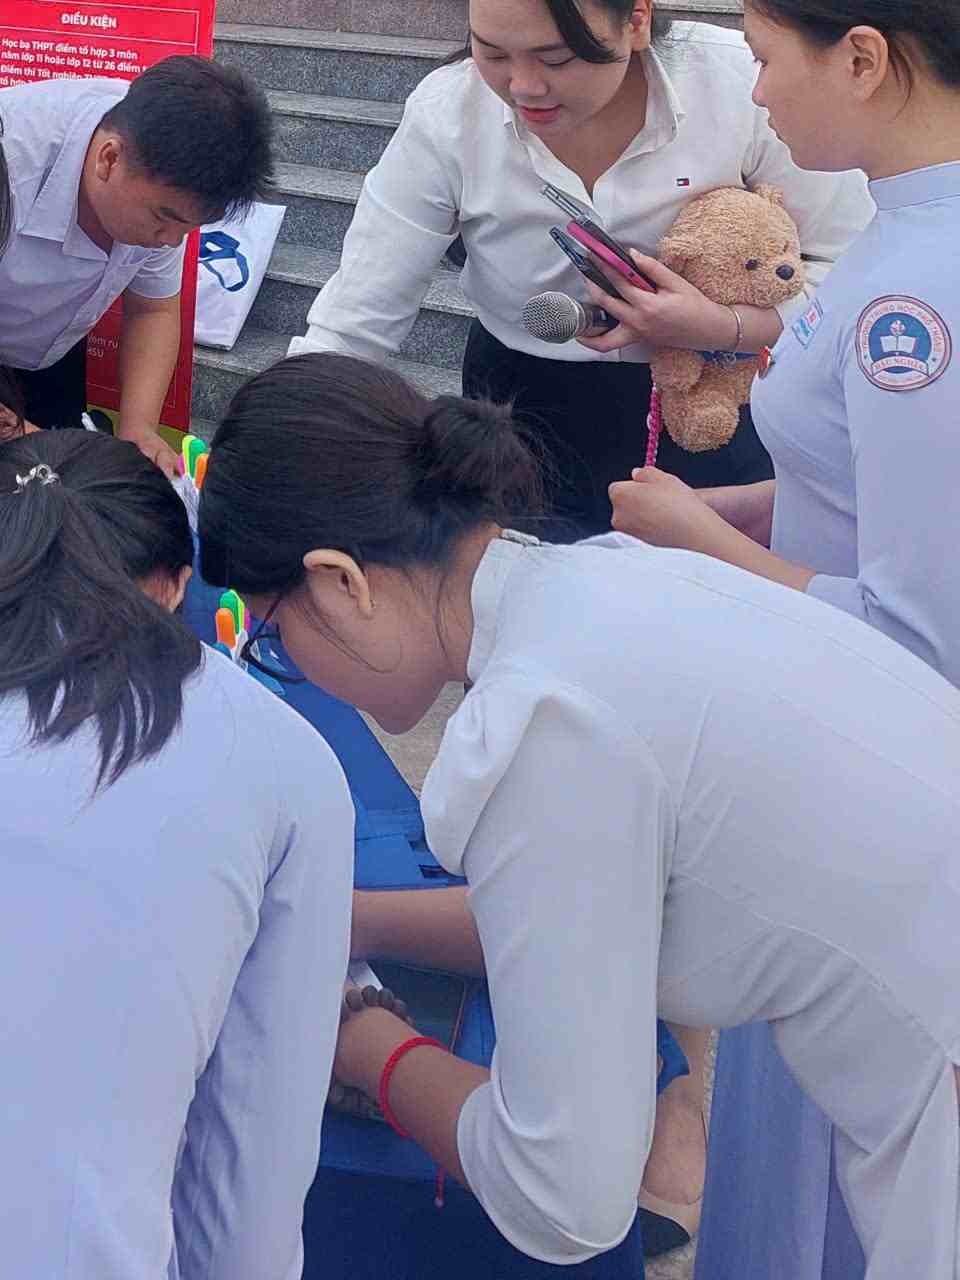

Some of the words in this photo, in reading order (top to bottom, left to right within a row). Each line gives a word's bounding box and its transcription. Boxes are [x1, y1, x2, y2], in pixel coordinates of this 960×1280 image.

[61, 12, 88, 26] ĐIỀU
[90, 16, 117, 30] KIỆN
[2, 38, 19, 50] Học
[31, 41, 54, 51] THPT
[109, 48, 116, 58] 3
[116, 49, 138, 60] môn
[0, 64, 23, 76] Điểm
[23, 65, 36, 76] thi
[1, 50, 20, 60] năm
[21, 52, 34, 63] lớp
[44, 54, 66, 67] hoặc
[66, 55, 81, 68] lớp
[82, 58, 92, 67] 12
[92, 58, 103, 69] từ
[104, 60, 116, 71] 26
[117, 61, 141, 73] điểm
